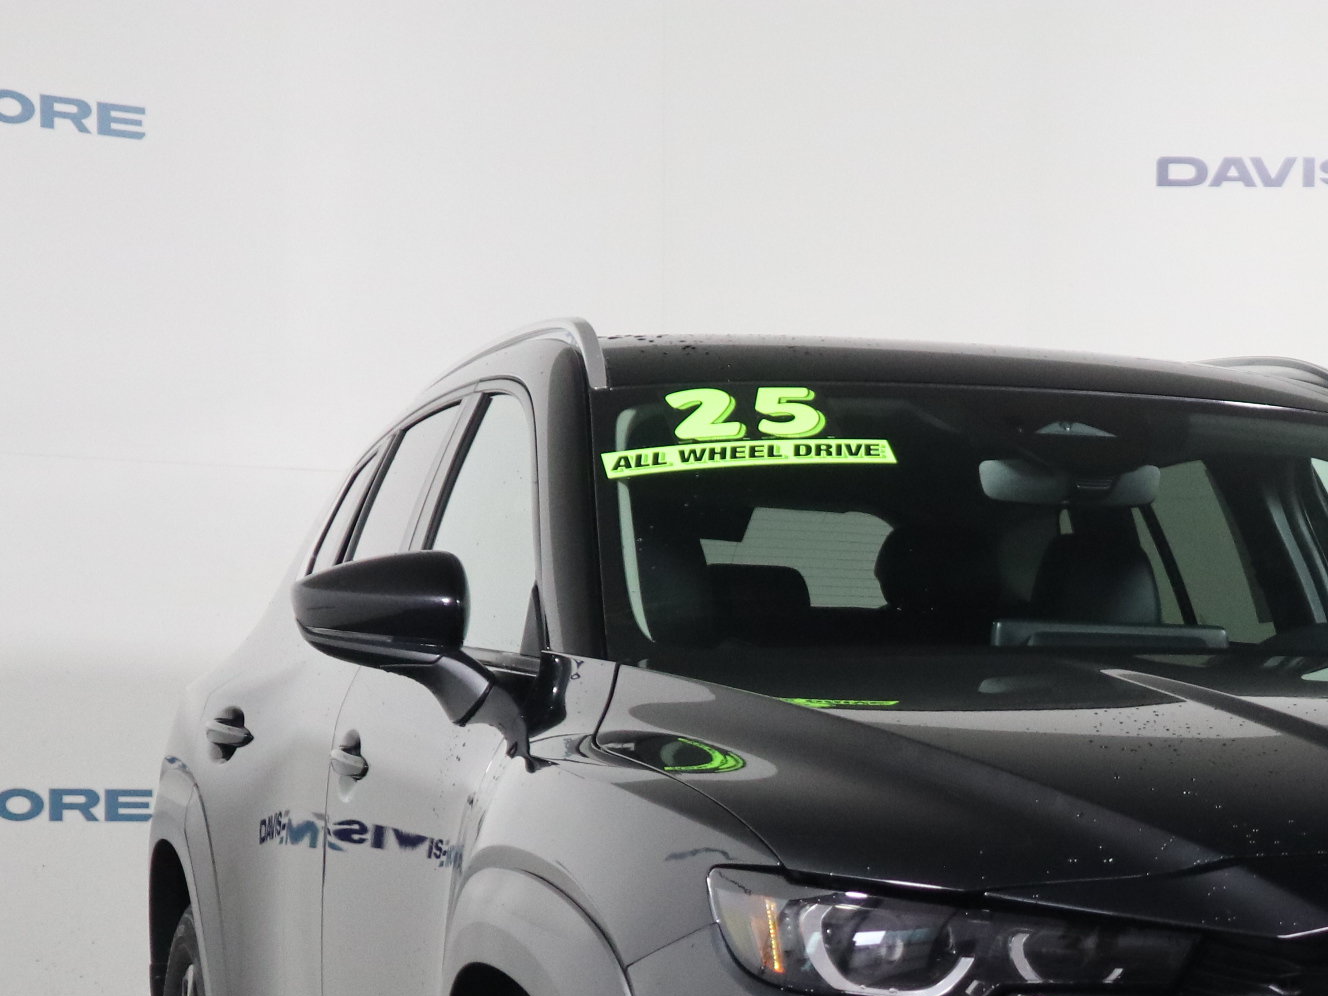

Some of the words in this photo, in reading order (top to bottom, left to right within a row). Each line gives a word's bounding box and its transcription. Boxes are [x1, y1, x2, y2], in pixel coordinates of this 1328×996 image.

[665, 387, 826, 440] 25
[611, 451, 671, 473] ALL
[678, 444, 786, 463] WHEEL
[792, 443, 885, 459] DRIVE
[0, 788, 153, 822] ORE
